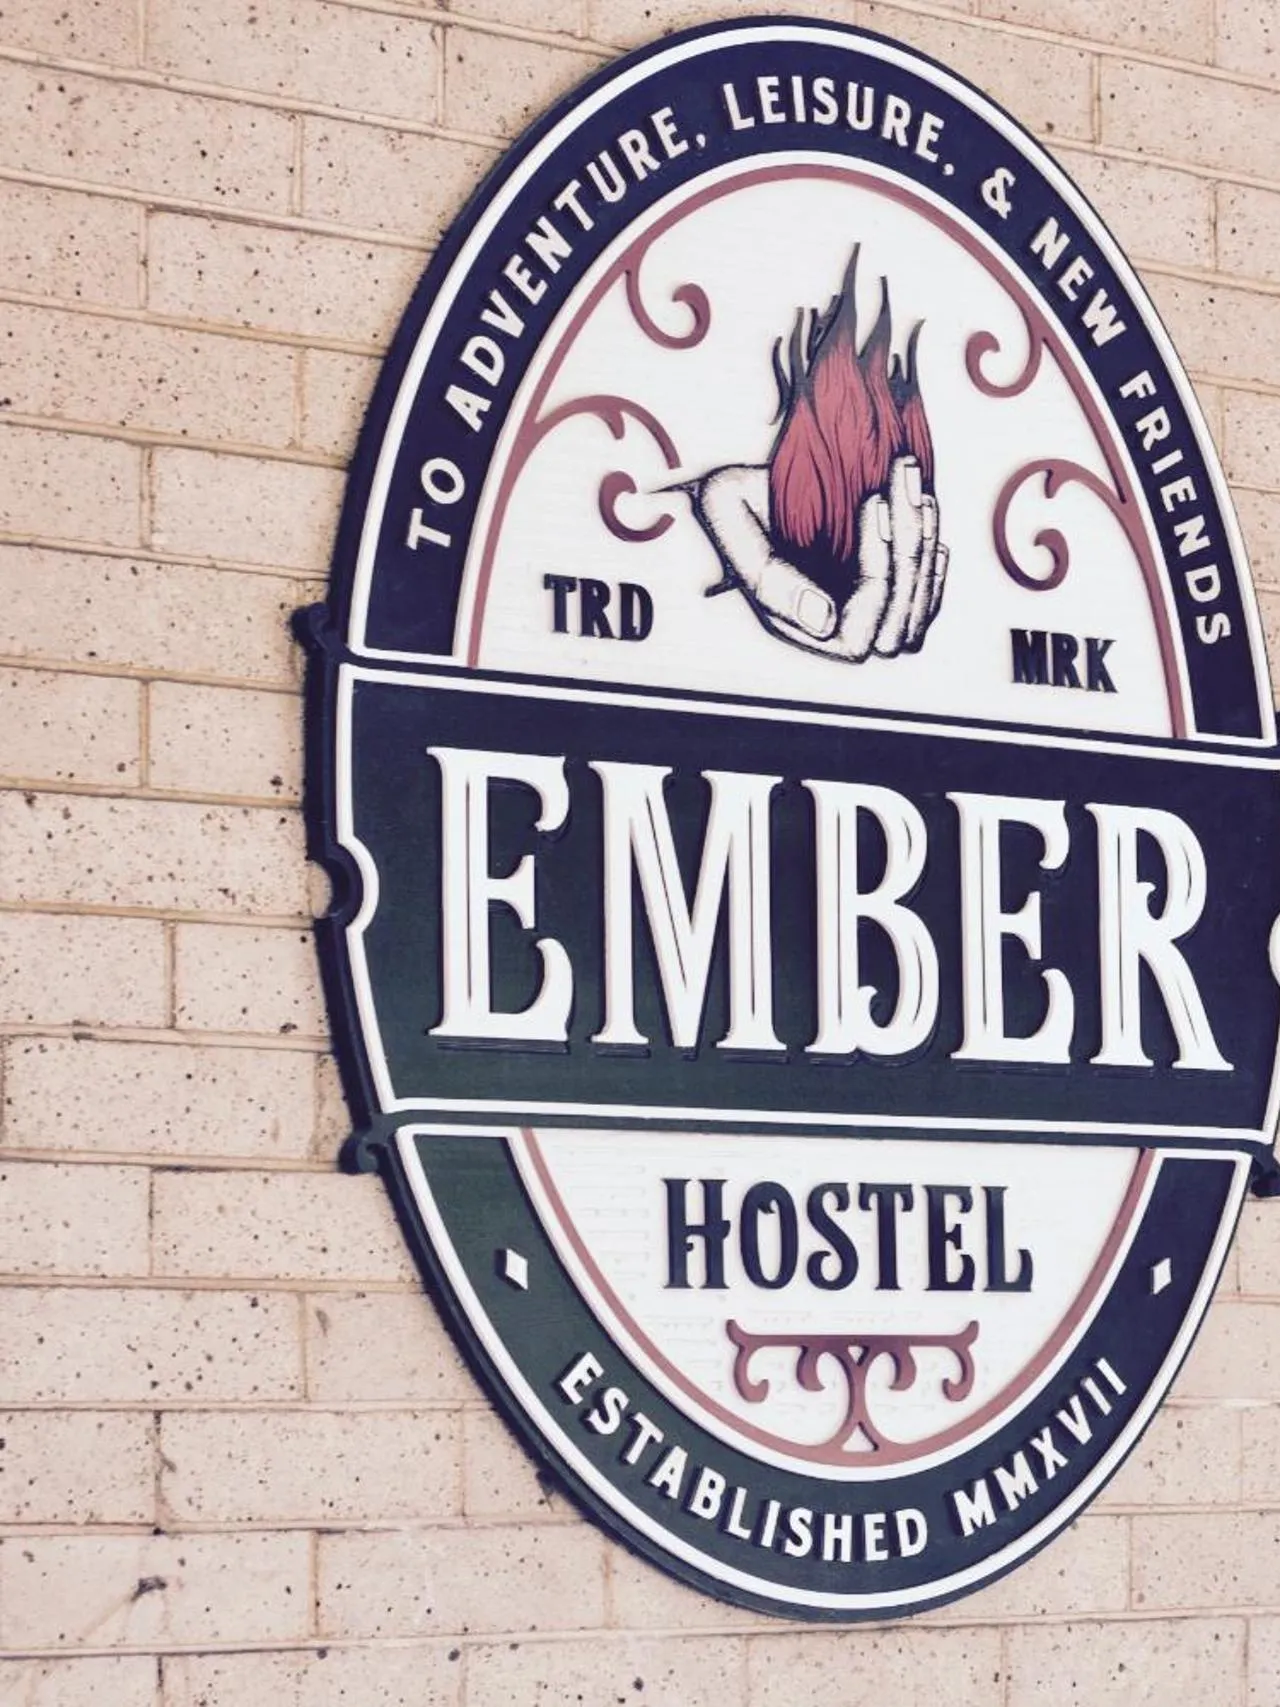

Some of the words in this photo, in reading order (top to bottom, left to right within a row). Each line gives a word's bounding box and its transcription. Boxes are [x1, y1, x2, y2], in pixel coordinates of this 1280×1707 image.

[408, 456, 465, 553] TO
[444, 106, 707, 433] ADVENTURE,
[722, 75, 955, 176] LEISURE,
[980, 166, 1018, 220] &
[1029, 216, 1127, 348] NEW
[1118, 369, 1232, 645] FRIENDS
[543, 573, 653, 642] TRD
[1010, 628, 1118, 694] MRK
[427, 745, 1235, 1073] EMBER
[661, 1177, 1034, 1293] HOSTEL
[557, 1351, 929, 1563] ESTABLISHED
[953, 1356, 1127, 1537] MMXVII
